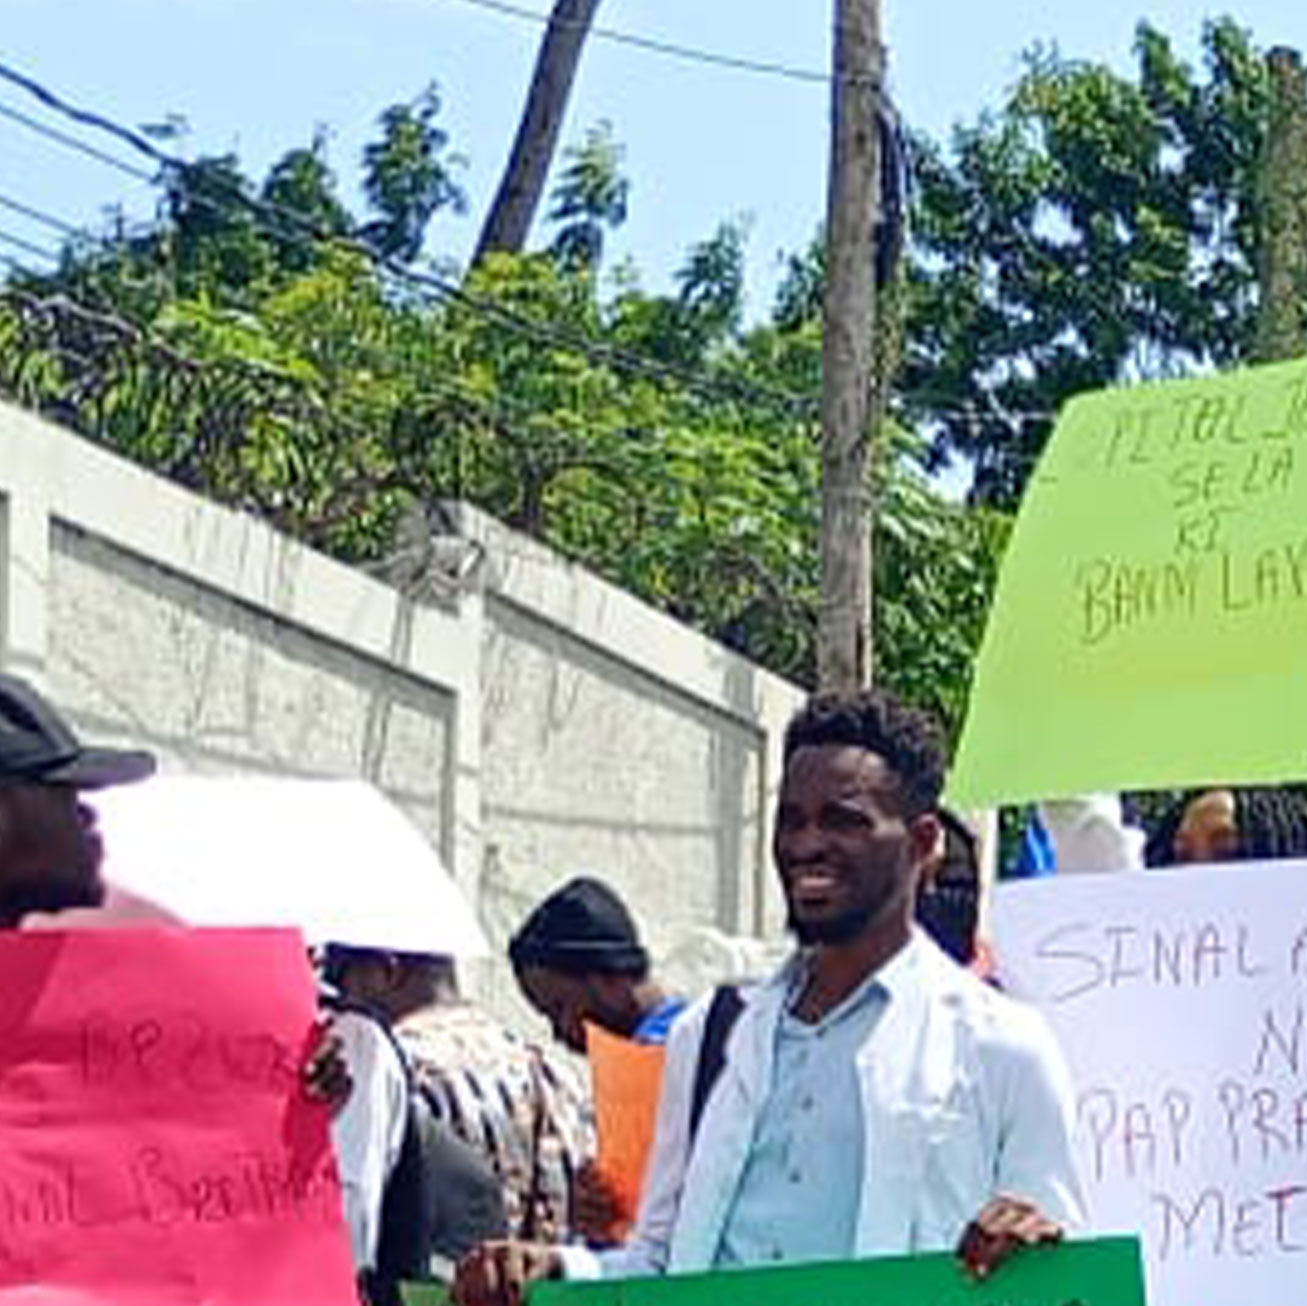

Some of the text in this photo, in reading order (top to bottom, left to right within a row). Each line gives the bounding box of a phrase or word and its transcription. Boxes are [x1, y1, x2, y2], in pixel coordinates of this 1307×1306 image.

[1240, 434, 1295, 495] LA
[1034, 921, 1270, 1001] SINAL
[1078, 1086, 1192, 1184] PAP
